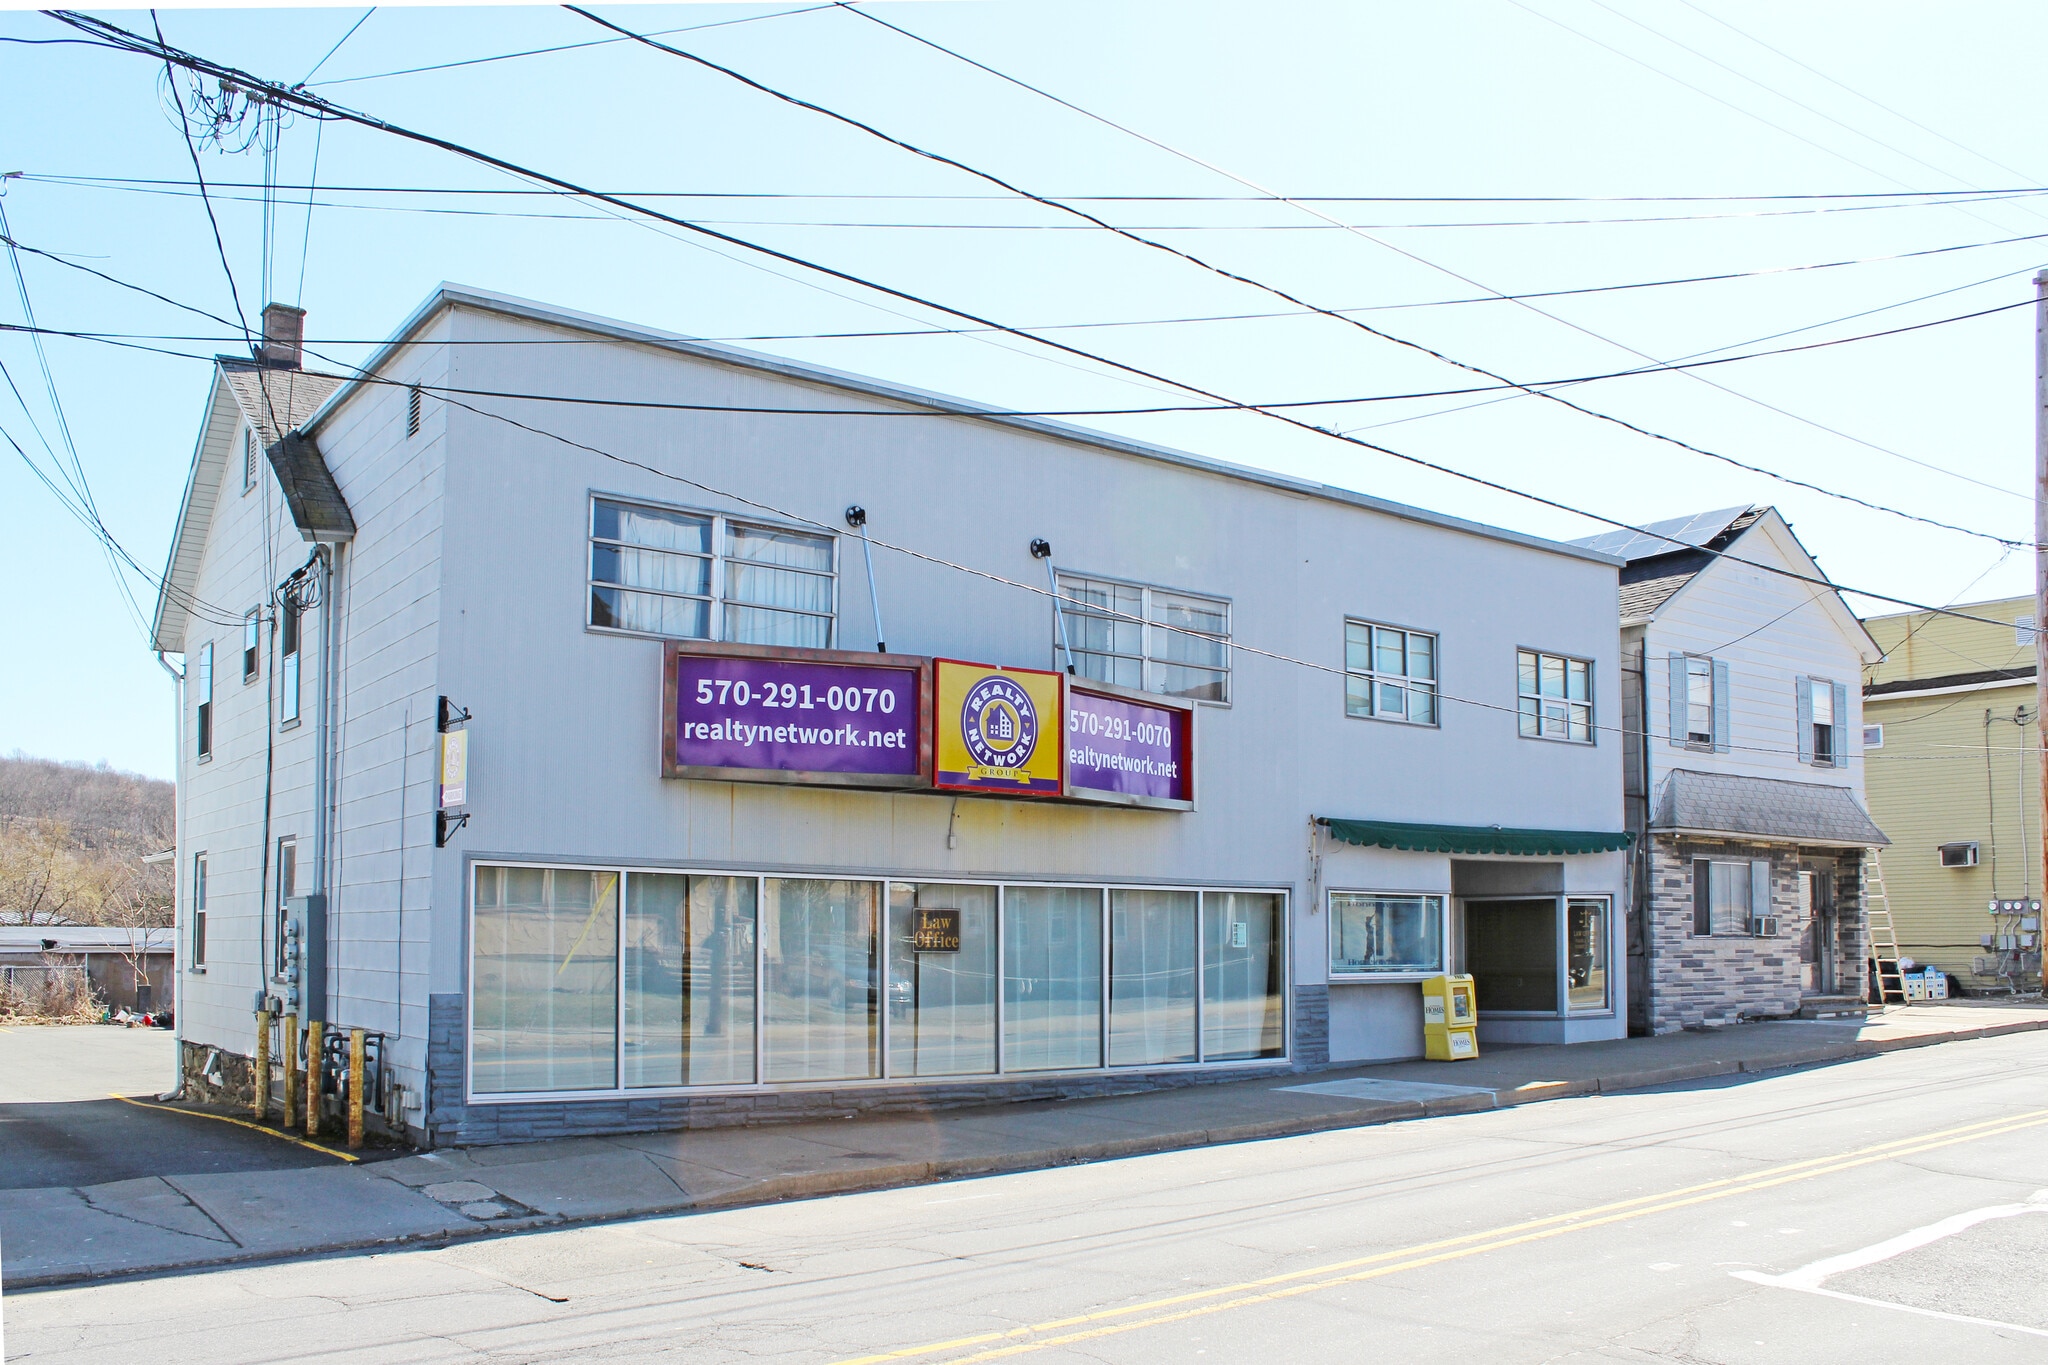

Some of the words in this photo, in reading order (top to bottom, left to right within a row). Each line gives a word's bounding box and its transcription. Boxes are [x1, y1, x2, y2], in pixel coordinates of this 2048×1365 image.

[696, 678, 896, 713] 570-291-0070
[970, 684, 1031, 718] REALTY
[684, 718, 906, 749] realtynetwork.net
[1069, 709, 1172, 748] 570-291-0070
[968, 728, 1032, 767] NETWORK
[1069, 745, 1177, 779] ealtynetwork.net
[980, 766, 1019, 778] GROUP
[922, 912, 951, 929] Law
[915, 931, 958, 948] Office
